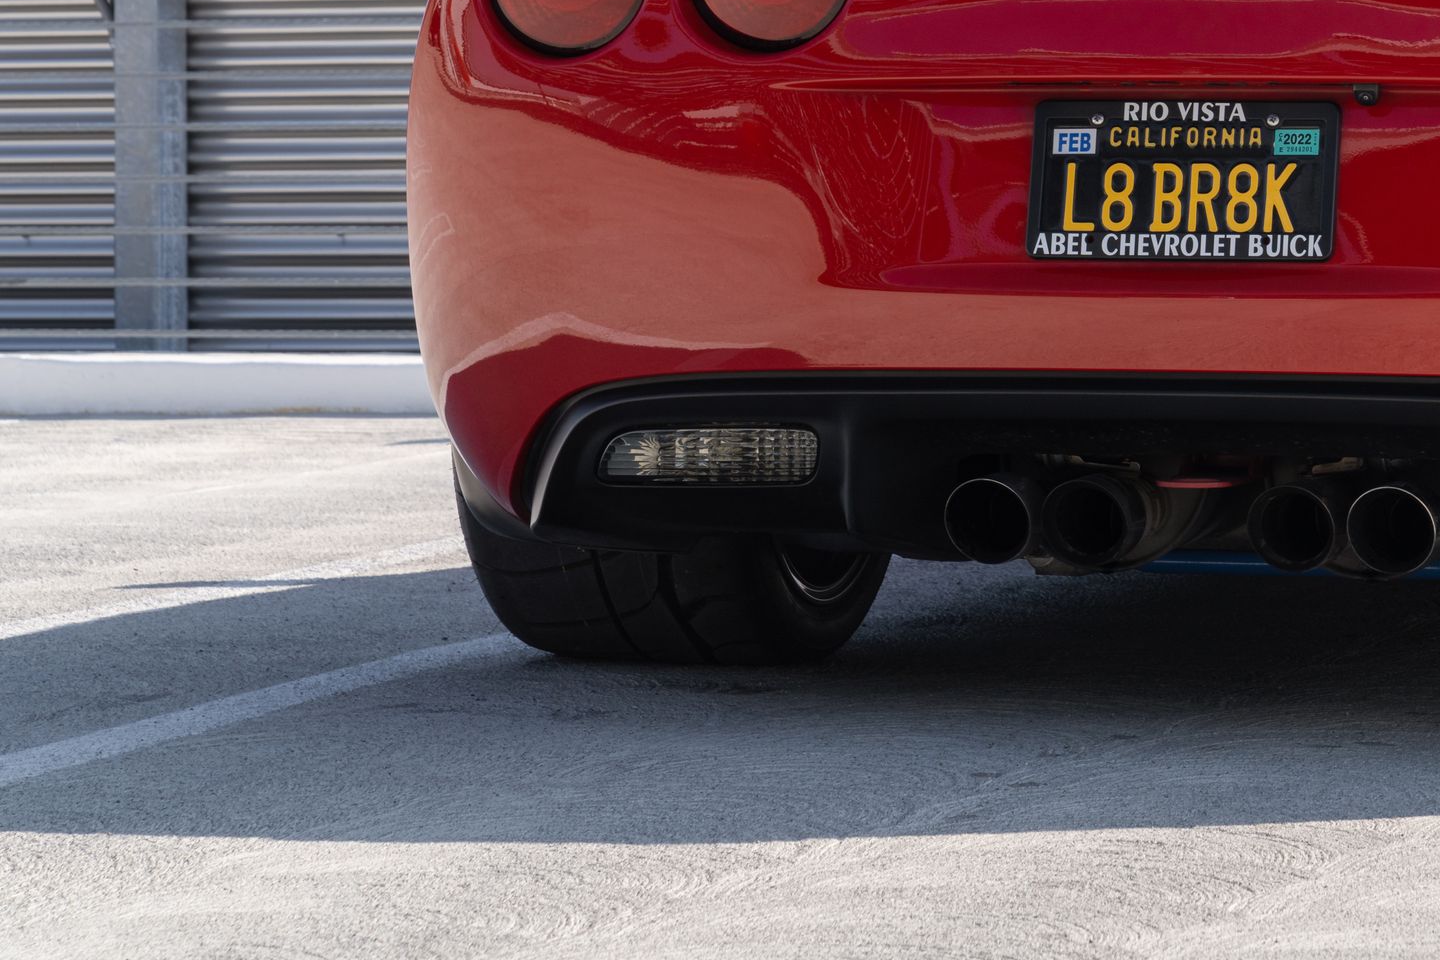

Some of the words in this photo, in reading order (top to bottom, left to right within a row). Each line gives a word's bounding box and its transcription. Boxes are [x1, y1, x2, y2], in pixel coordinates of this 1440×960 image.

[1123, 102, 1169, 122] RIO
[1177, 103, 1246, 122] VISTA
[1058, 133, 1091, 152] FEB
[1109, 127, 1262, 147] CALIFORNIA
[1283, 133, 1312, 145] 2022
[1063, 163, 1135, 231] L8
[1150, 163, 1297, 232] BR8K
[1033, 233, 1093, 255] ABEL
[1101, 233, 1241, 256] CHEVROLET
[1248, 234, 1323, 257] BUICK
